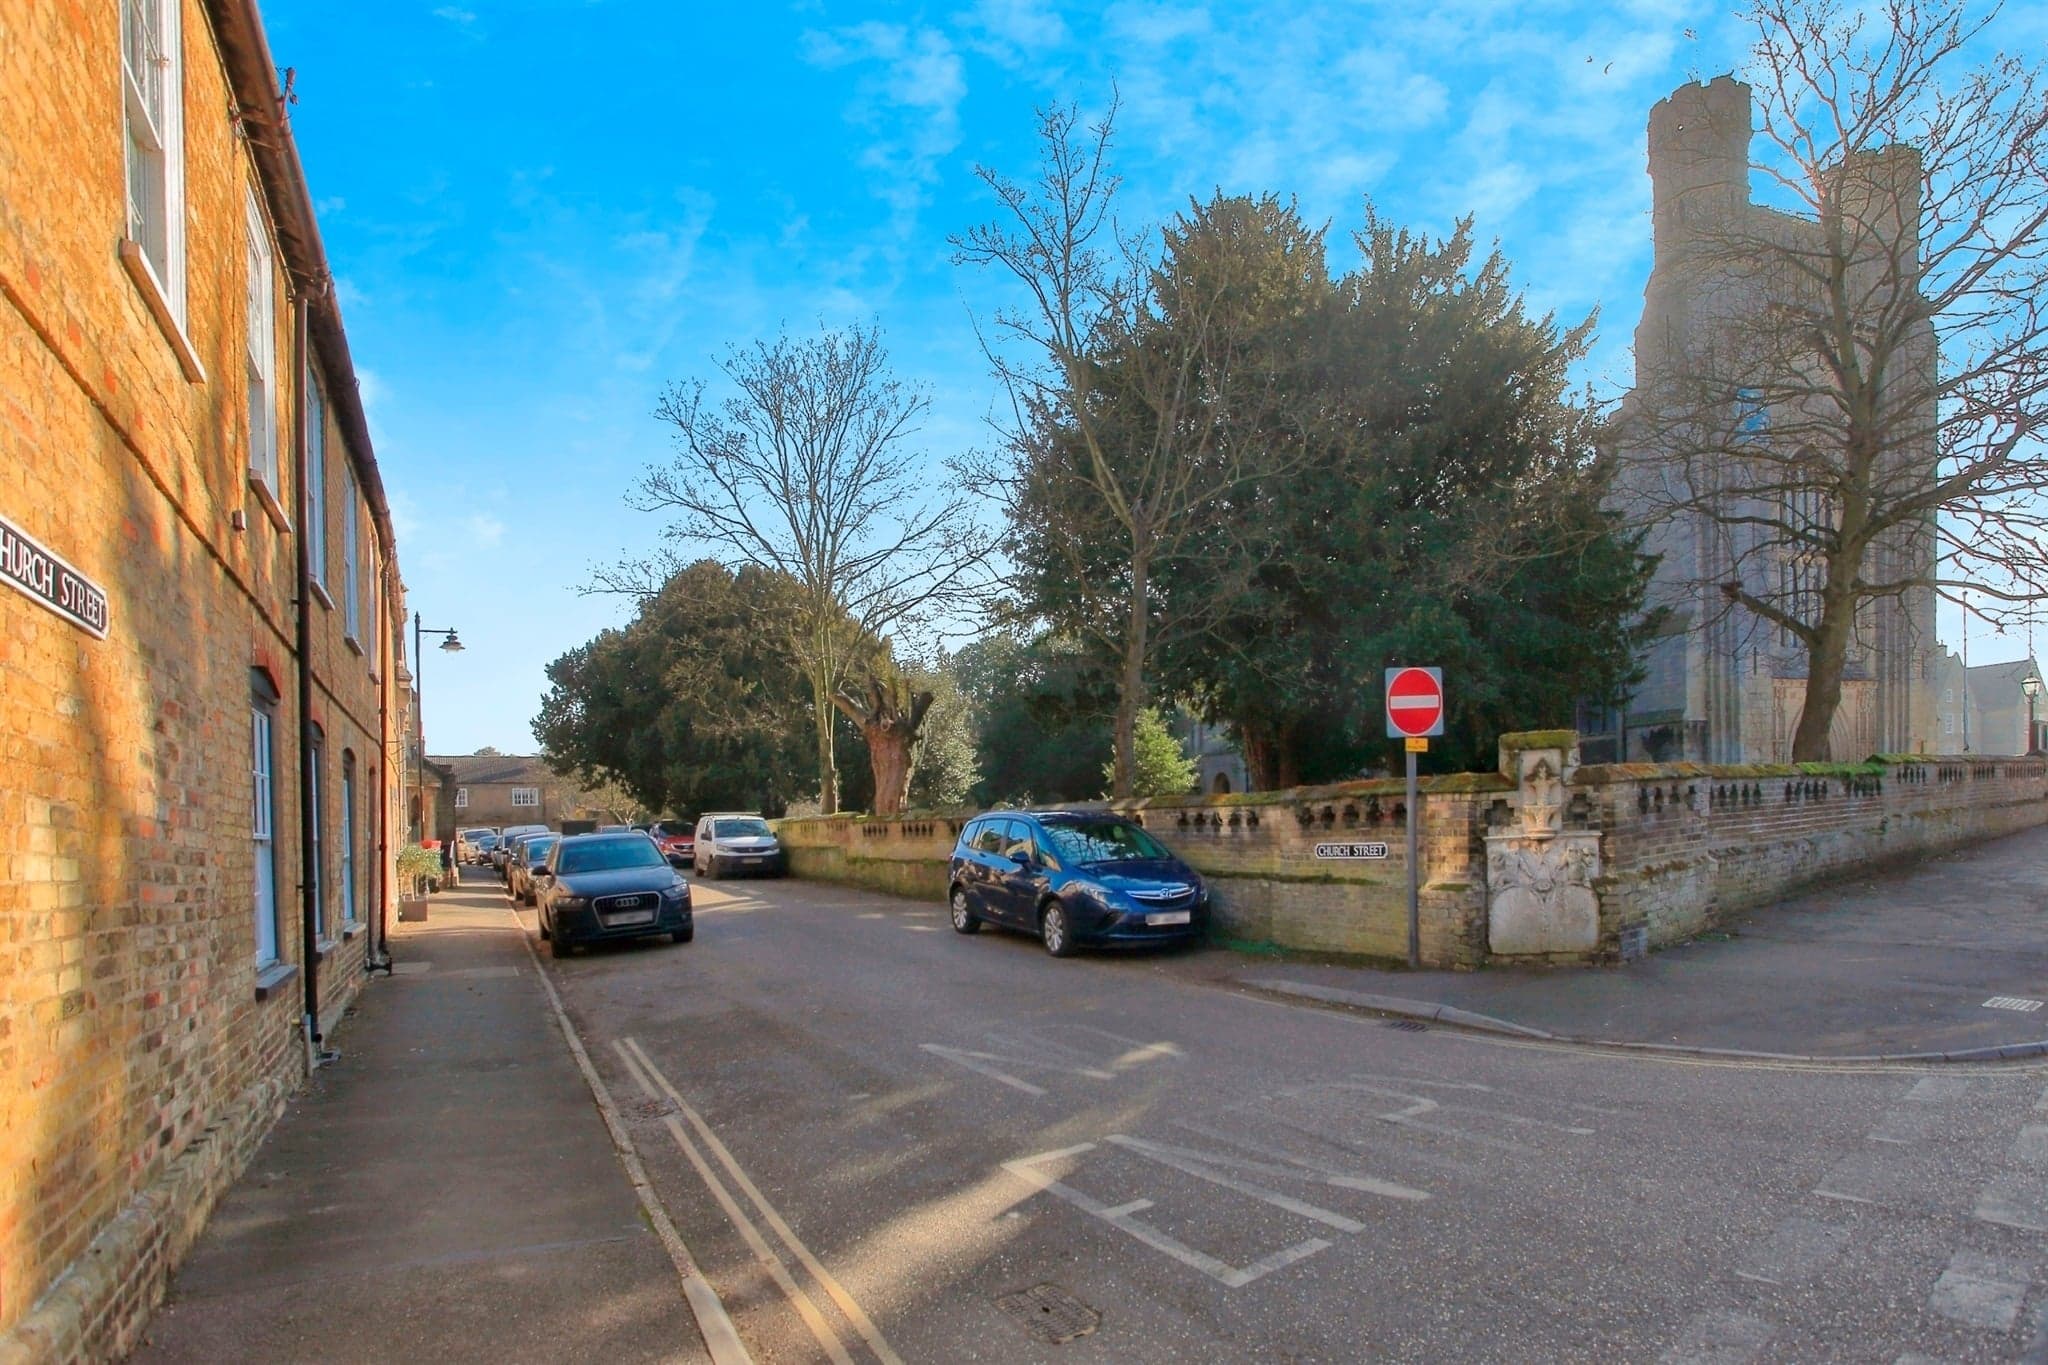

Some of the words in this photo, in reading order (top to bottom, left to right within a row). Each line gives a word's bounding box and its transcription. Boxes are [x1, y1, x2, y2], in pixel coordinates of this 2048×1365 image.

[0, 527, 54, 598] HURCH
[61, 571, 105, 627] STREET
[1318, 846, 1350, 856] CHURCH
[1353, 845, 1383, 856] STREET
